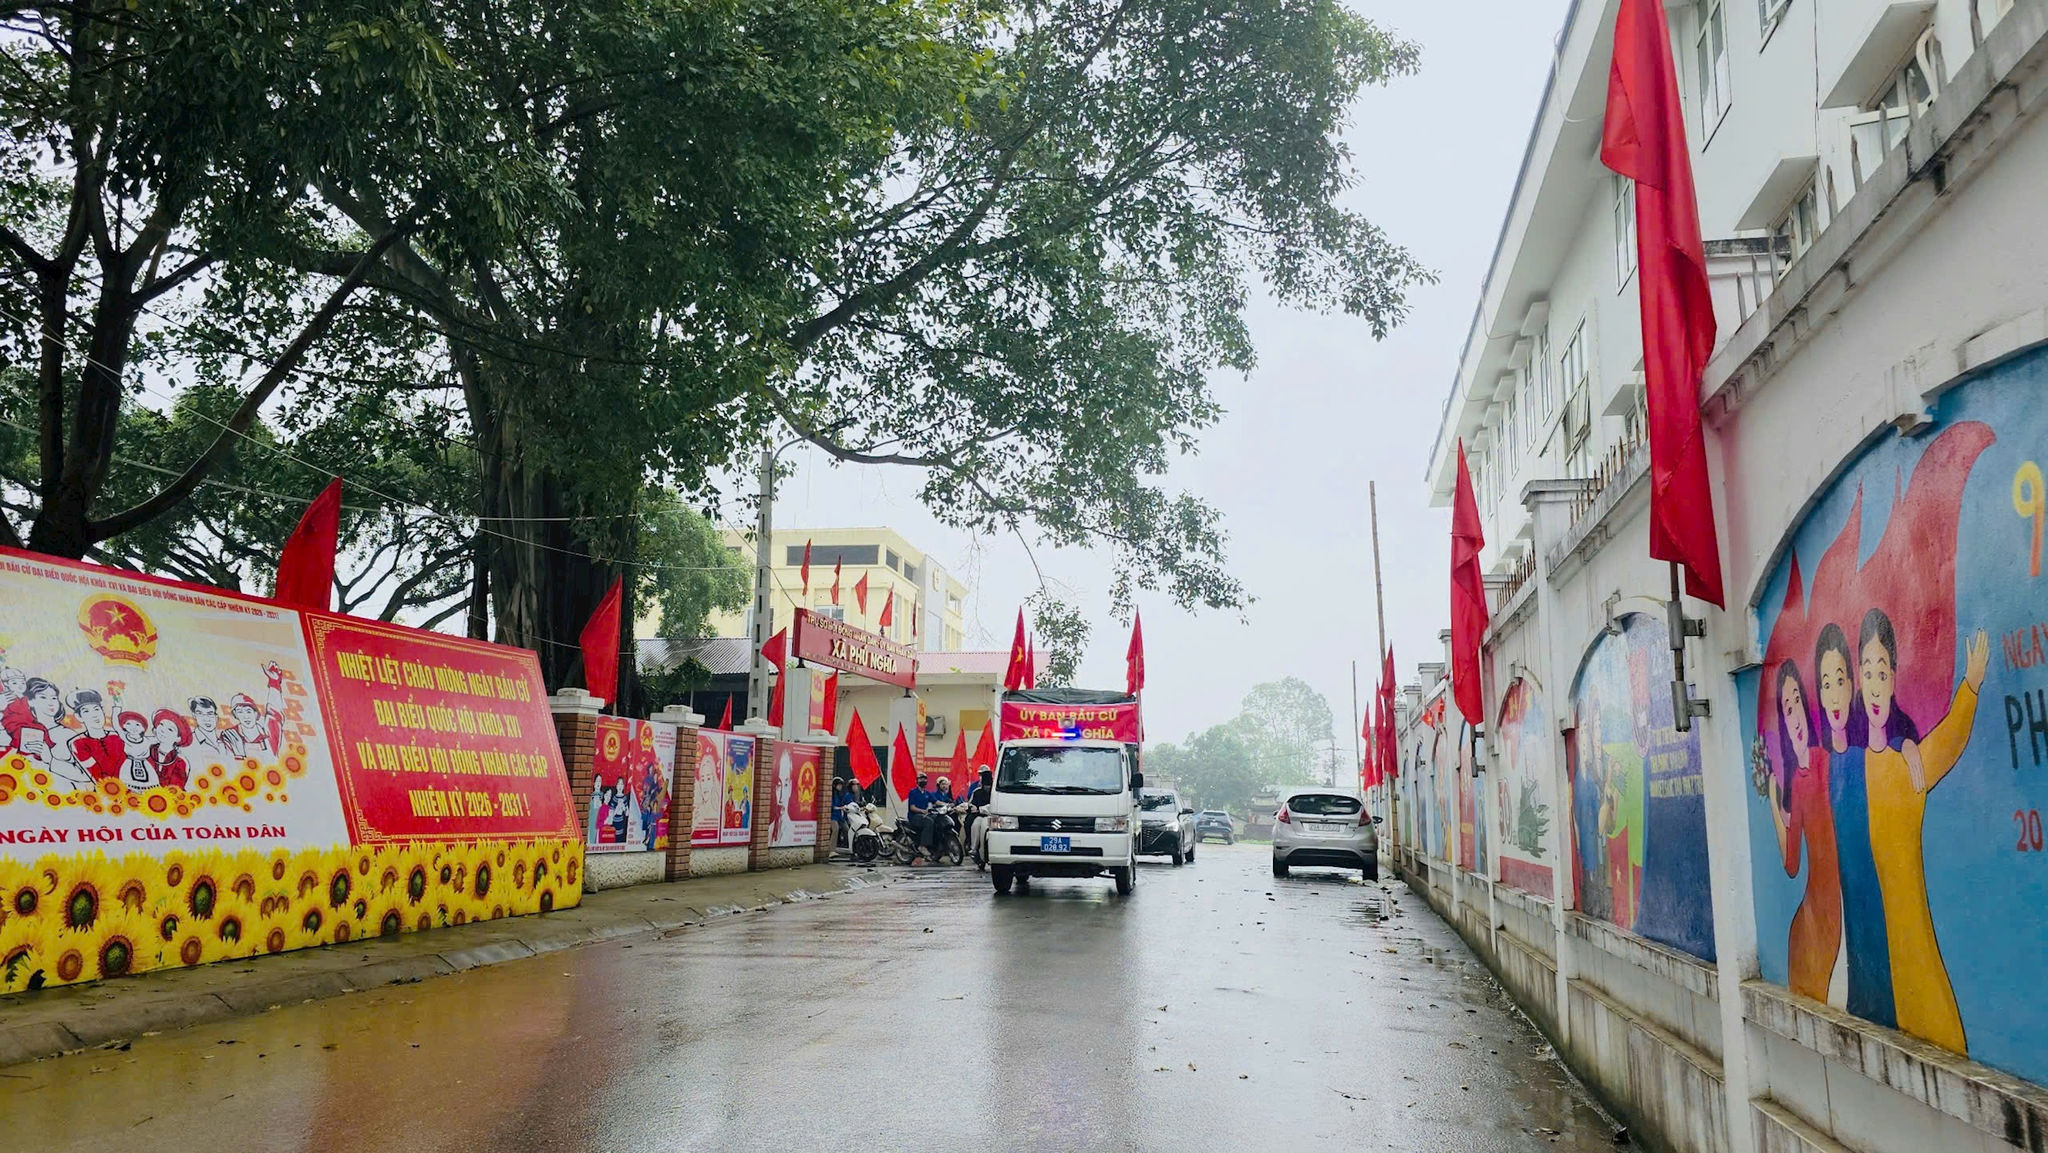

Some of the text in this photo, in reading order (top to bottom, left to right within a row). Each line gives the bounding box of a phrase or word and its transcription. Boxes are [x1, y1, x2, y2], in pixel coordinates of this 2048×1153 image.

[336, 649, 531, 703] NHIỆT LIỆT CHÀO MỪNG NGÀY BẦU CỬ
[850, 644, 868, 666] PHÚ
[870, 654, 898, 675] NGHĨA
[374, 694, 522, 739] ĐẠI BIỂU QUỐC HỘI KHÓA XVI
[1020, 708, 1117, 720] ỦY BAN BẦU CỬ
[1022, 726, 1040, 738] XÃ
[1079, 726, 1115, 739] GHĨA
[356, 736, 548, 779] VÀ ĐẠI BIỂU HỘI ĐỒNG NHÂN CÁC CẤP
[409, 784, 450, 823] NHIỆM
[448, 786, 465, 817] KỲ
[465, 792, 493, 817] 2026
[499, 792, 524, 817] 2031
[0, 823, 286, 844] NGÀY HỘI CỦA TOÀN DÂN
